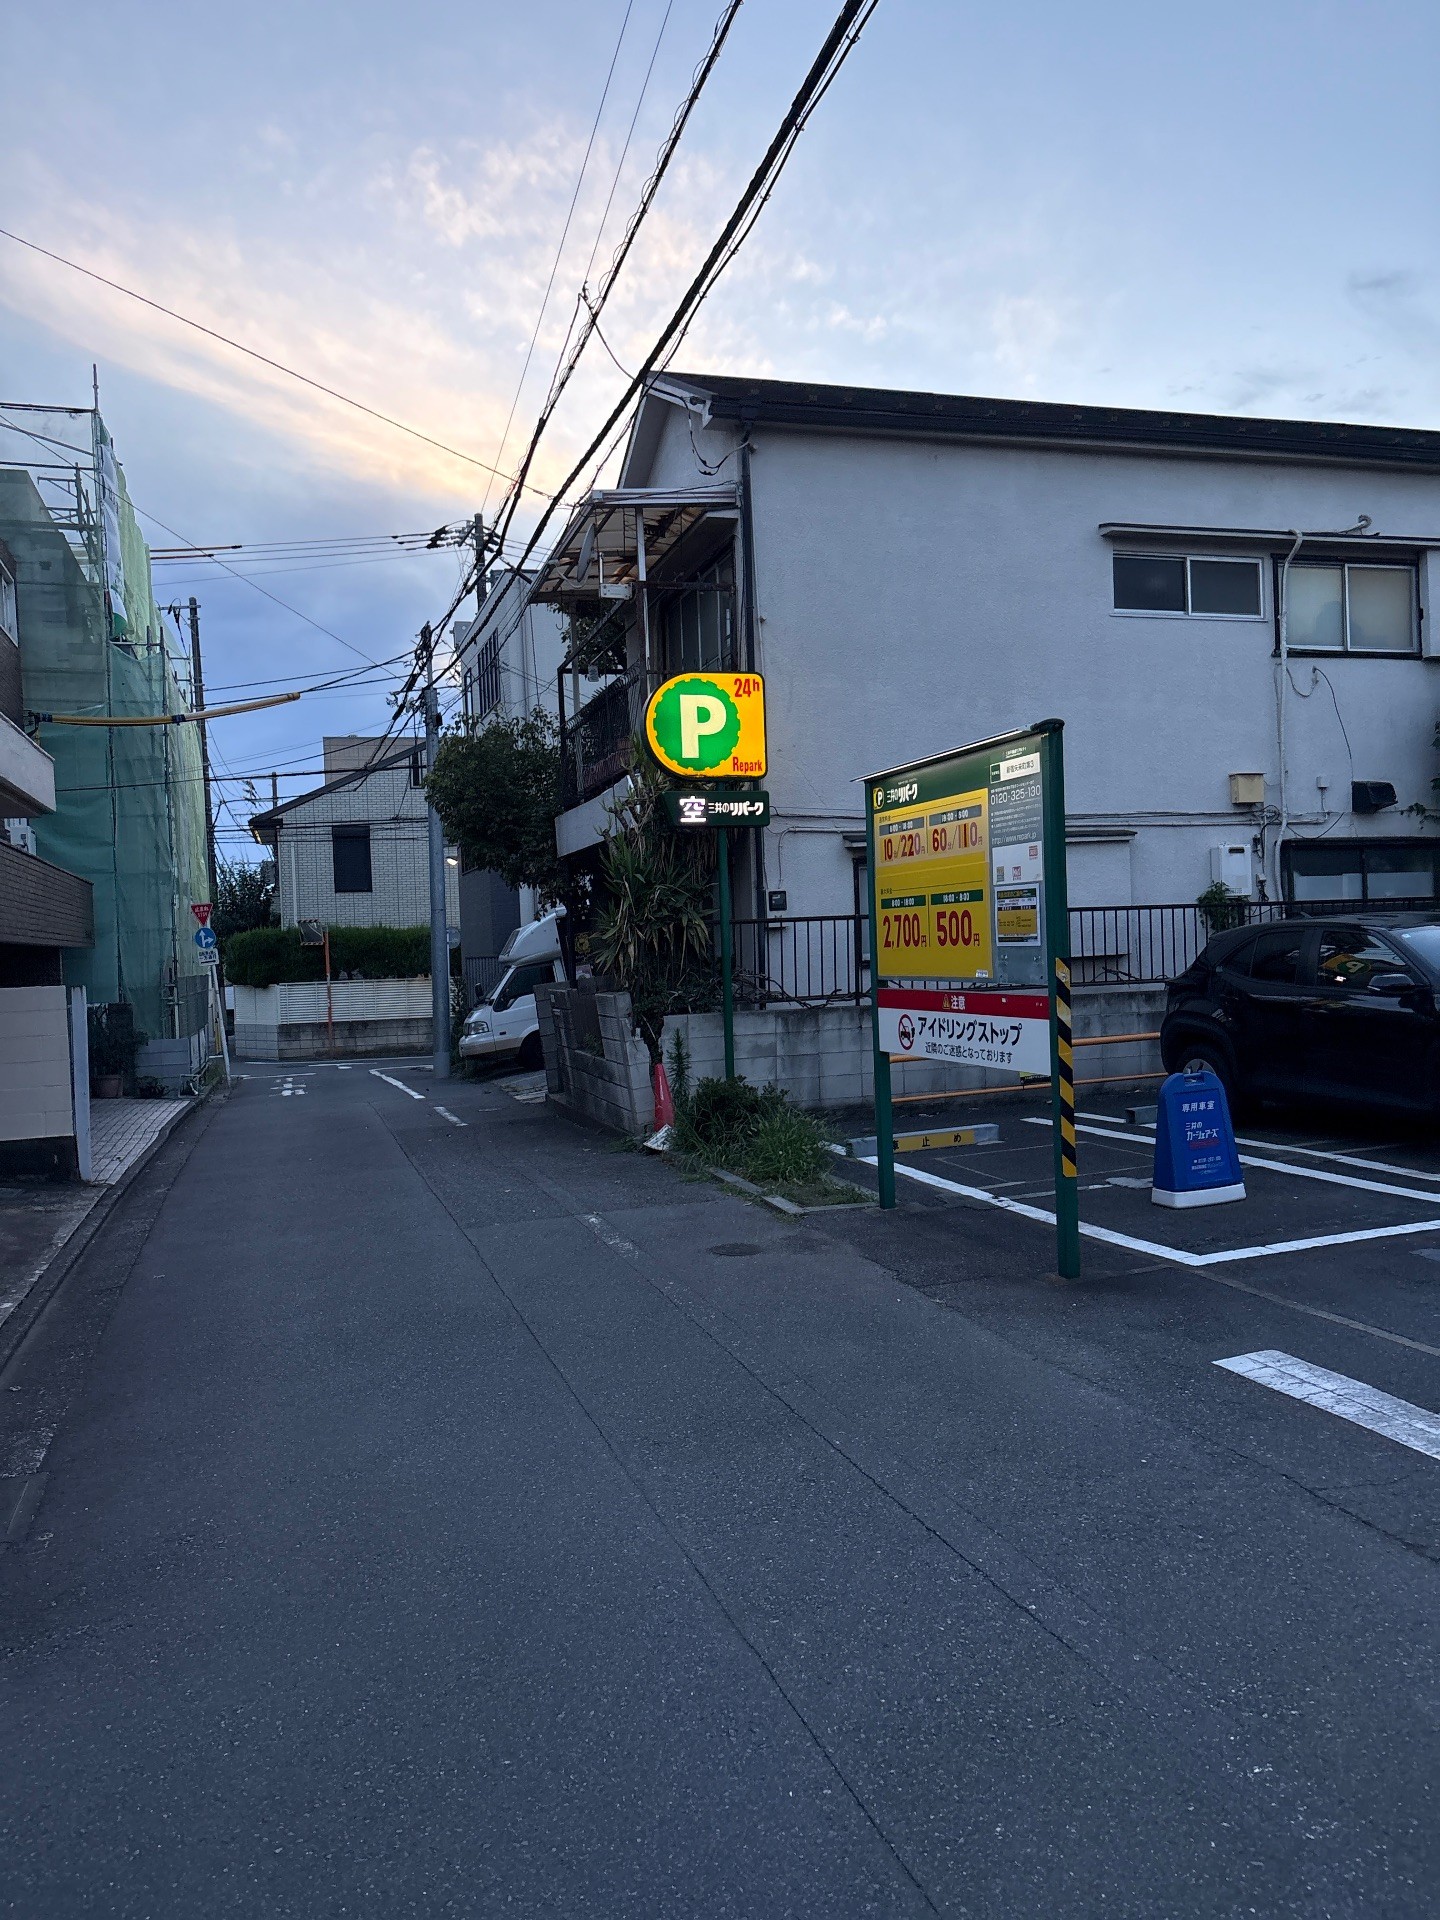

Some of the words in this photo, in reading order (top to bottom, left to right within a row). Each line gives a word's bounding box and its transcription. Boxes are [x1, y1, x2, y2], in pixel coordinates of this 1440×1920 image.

[734, 678, 760, 697] 24h
[680, 694, 726, 758] P
[732, 756, 763, 773] Repark
[886, 783, 918, 804] 三井のリパーク
[991, 785, 1041, 805] 0120-325-130
[679, 796, 707, 823] 空
[708, 802, 764, 816] 三井のリパーク
[883, 912, 927, 949] 2,700円
[936, 909, 980, 947] 500円
[951, 995, 966, 1010] 注意
[918, 1017, 1023, 1046] アイドリングストップ
[925, 1041, 1013, 1064] 近隣のご迷惑となっております
[1182, 1100, 1215, 1113] 専用車室
[1185, 1121, 1203, 1131] 三井の
